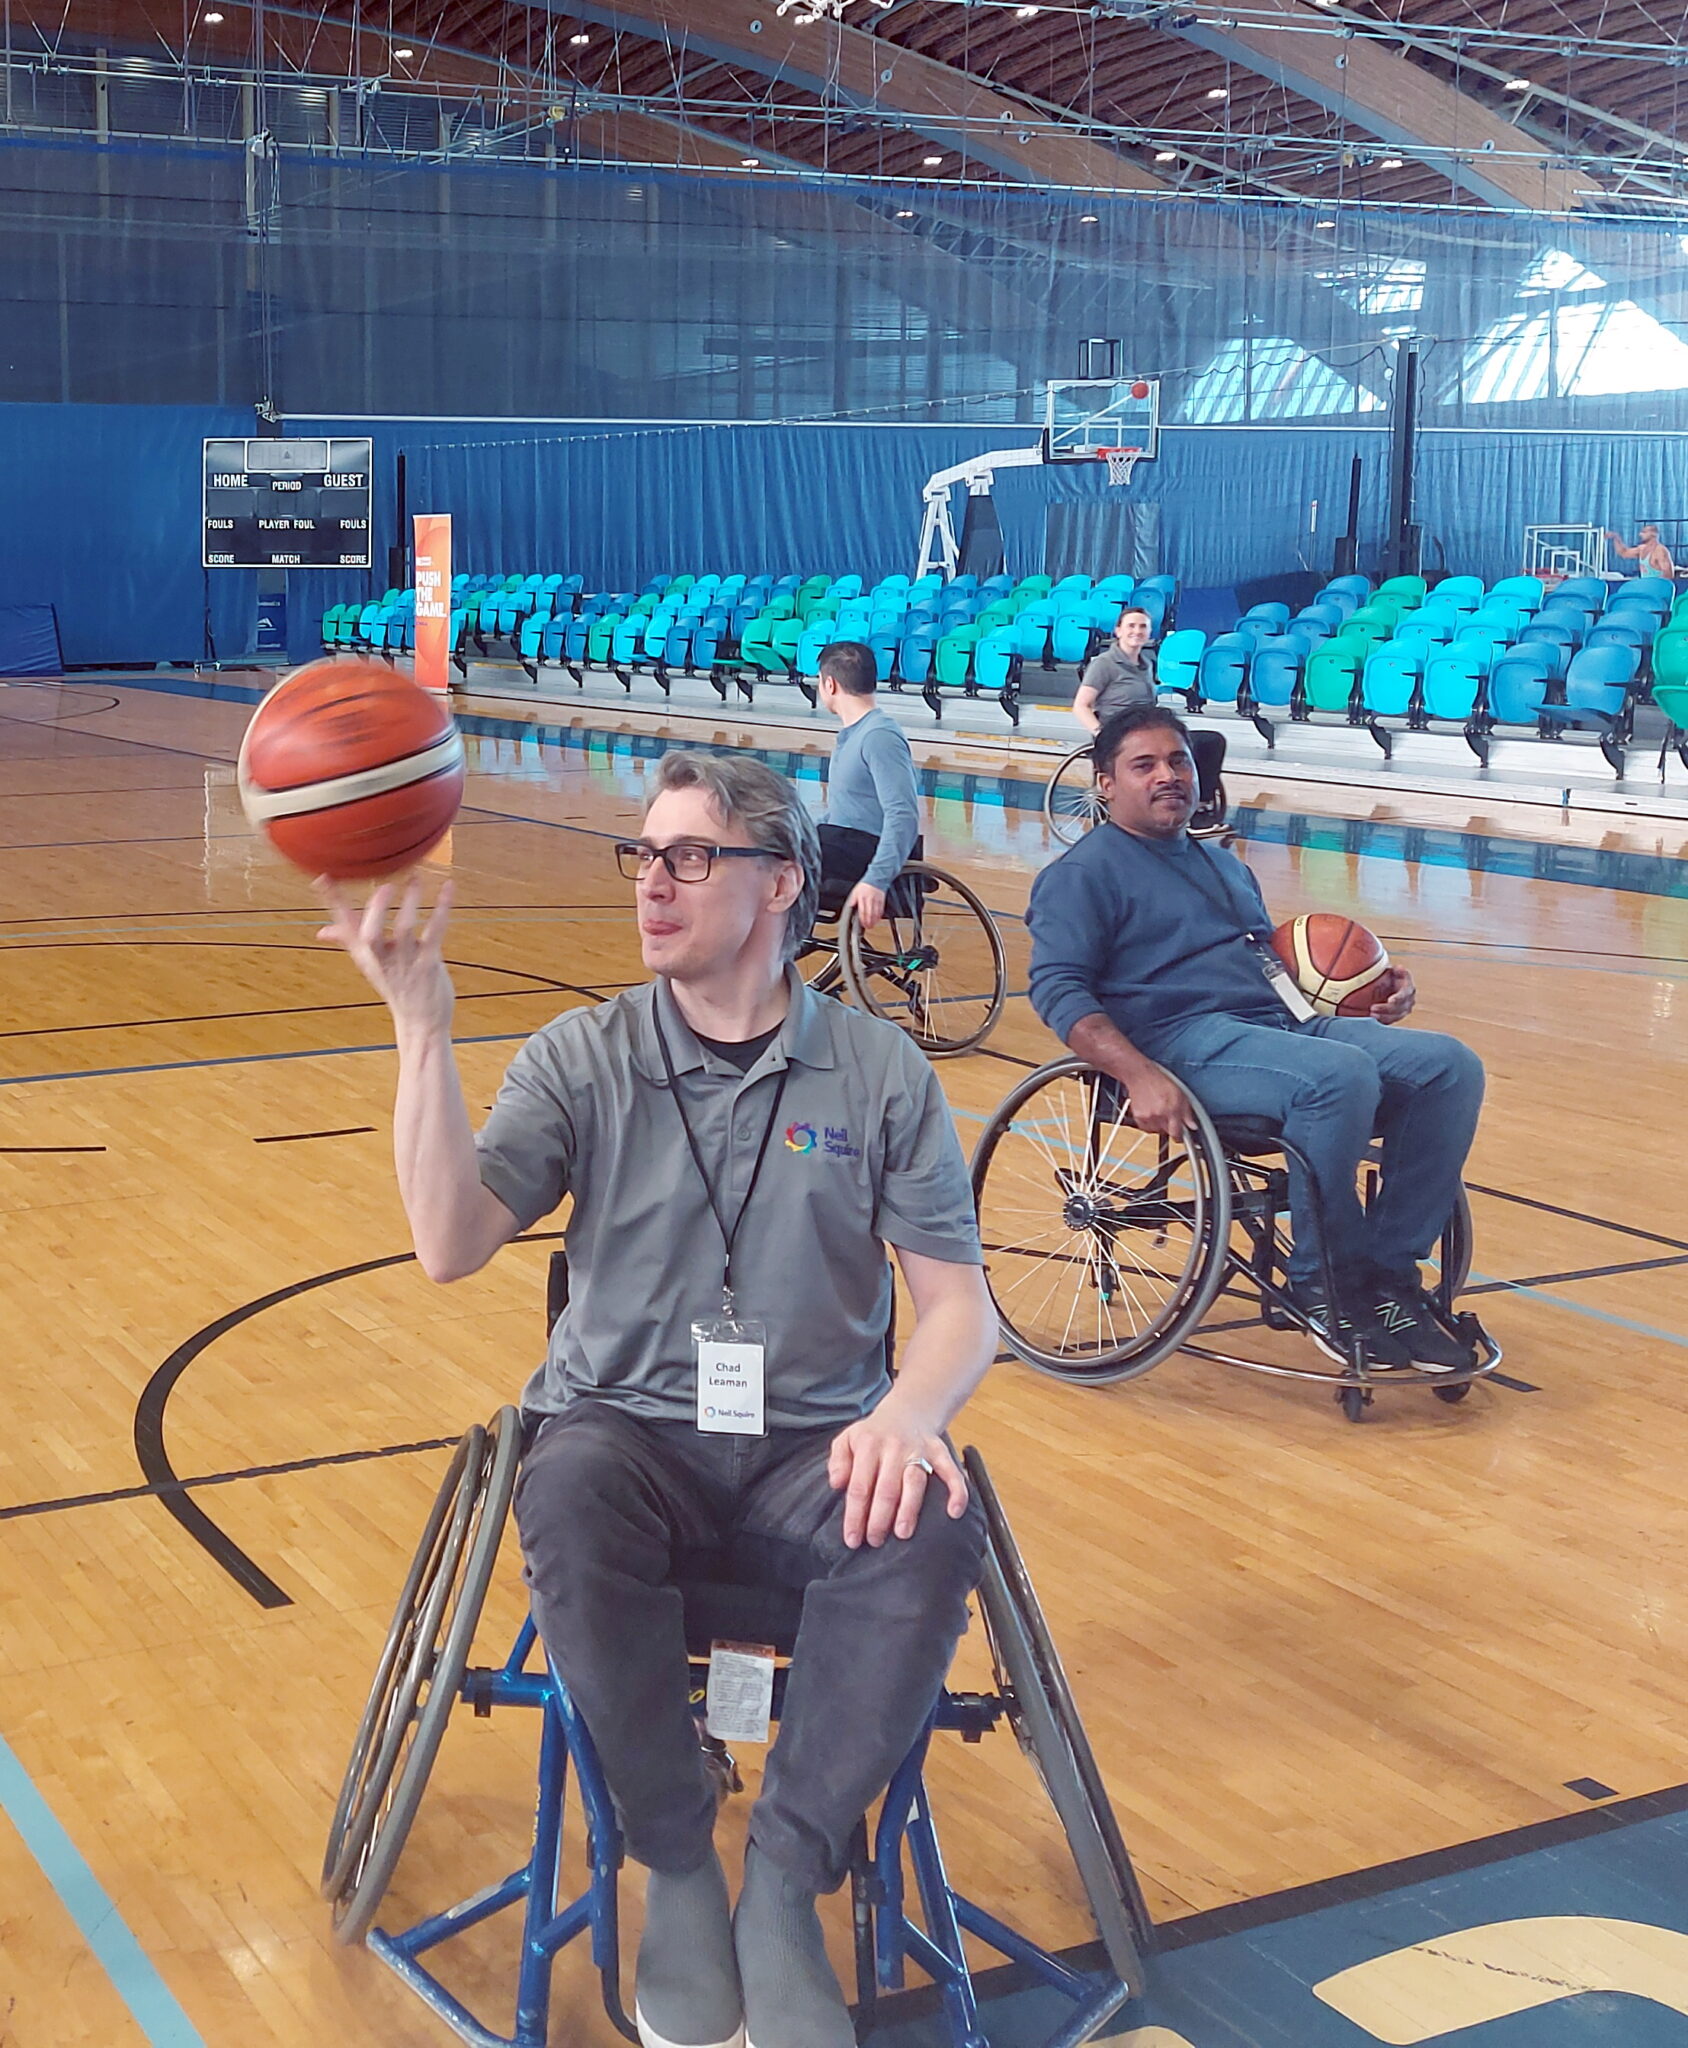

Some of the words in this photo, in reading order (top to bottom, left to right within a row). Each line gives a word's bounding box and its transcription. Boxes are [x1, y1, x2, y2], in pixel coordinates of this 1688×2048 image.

[213, 474, 249, 487] HOME
[323, 474, 364, 487] GUEST
[272, 481, 302, 491] PERIOD
[207, 520, 234, 529] FOULS
[258, 520, 290, 529] PLAYER
[294, 520, 315, 529] FOUL
[340, 520, 367, 529] FOULS
[208, 554, 235, 563] SCORE
[271, 554, 301, 564] MATCH
[340, 554, 367, 564] SCORE
[415, 570, 442, 587] PUSH
[415, 586, 433, 602] THE
[824, 1127, 848, 1142] Neil
[824, 1141, 860, 1158] Squire
[715, 1362, 741, 1372] Chad
[708, 1376, 748, 1388] Leaman
[718, 1408, 732, 1417] Neil
[733, 1409, 755, 1418] Squire
